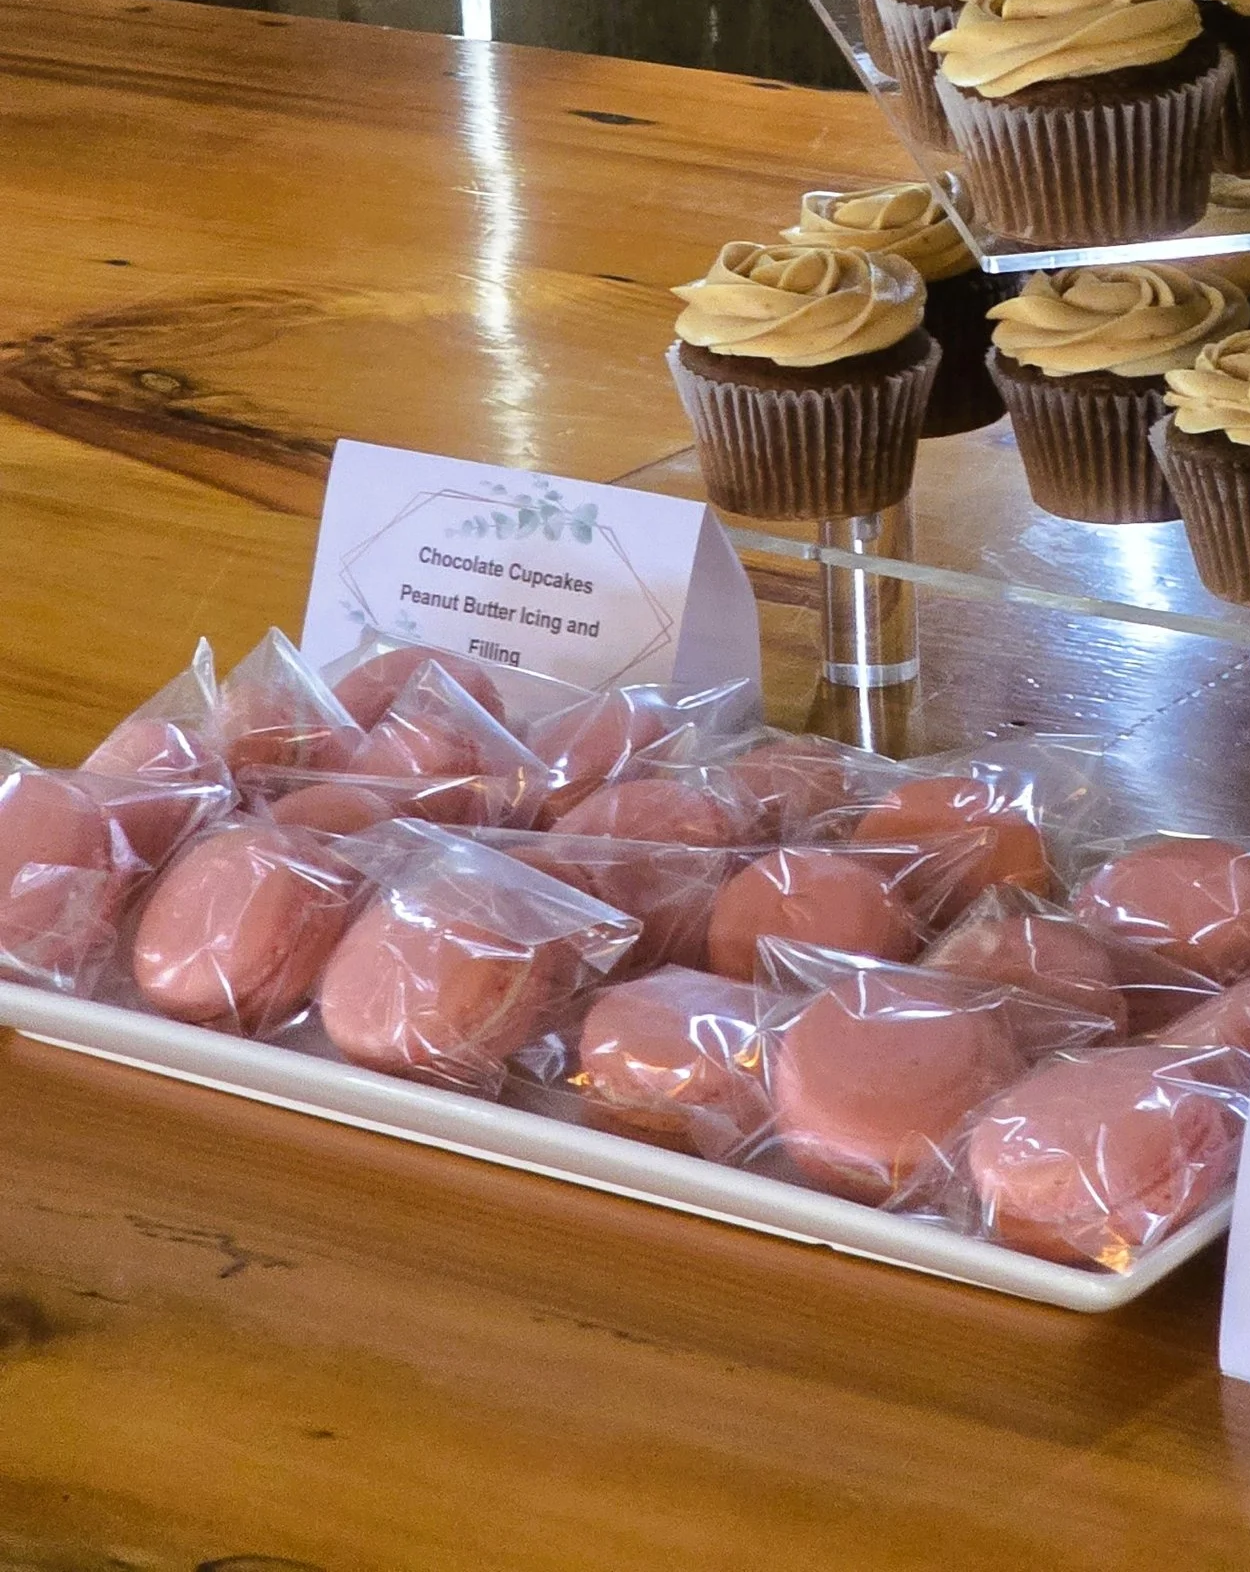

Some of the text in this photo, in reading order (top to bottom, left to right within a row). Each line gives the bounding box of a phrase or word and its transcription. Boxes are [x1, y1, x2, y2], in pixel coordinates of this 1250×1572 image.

[419, 546, 593, 594] Chocolate Cupcakes
[400, 585, 600, 638] Peanut Butter Icing and
[468, 638, 521, 668] Filling
